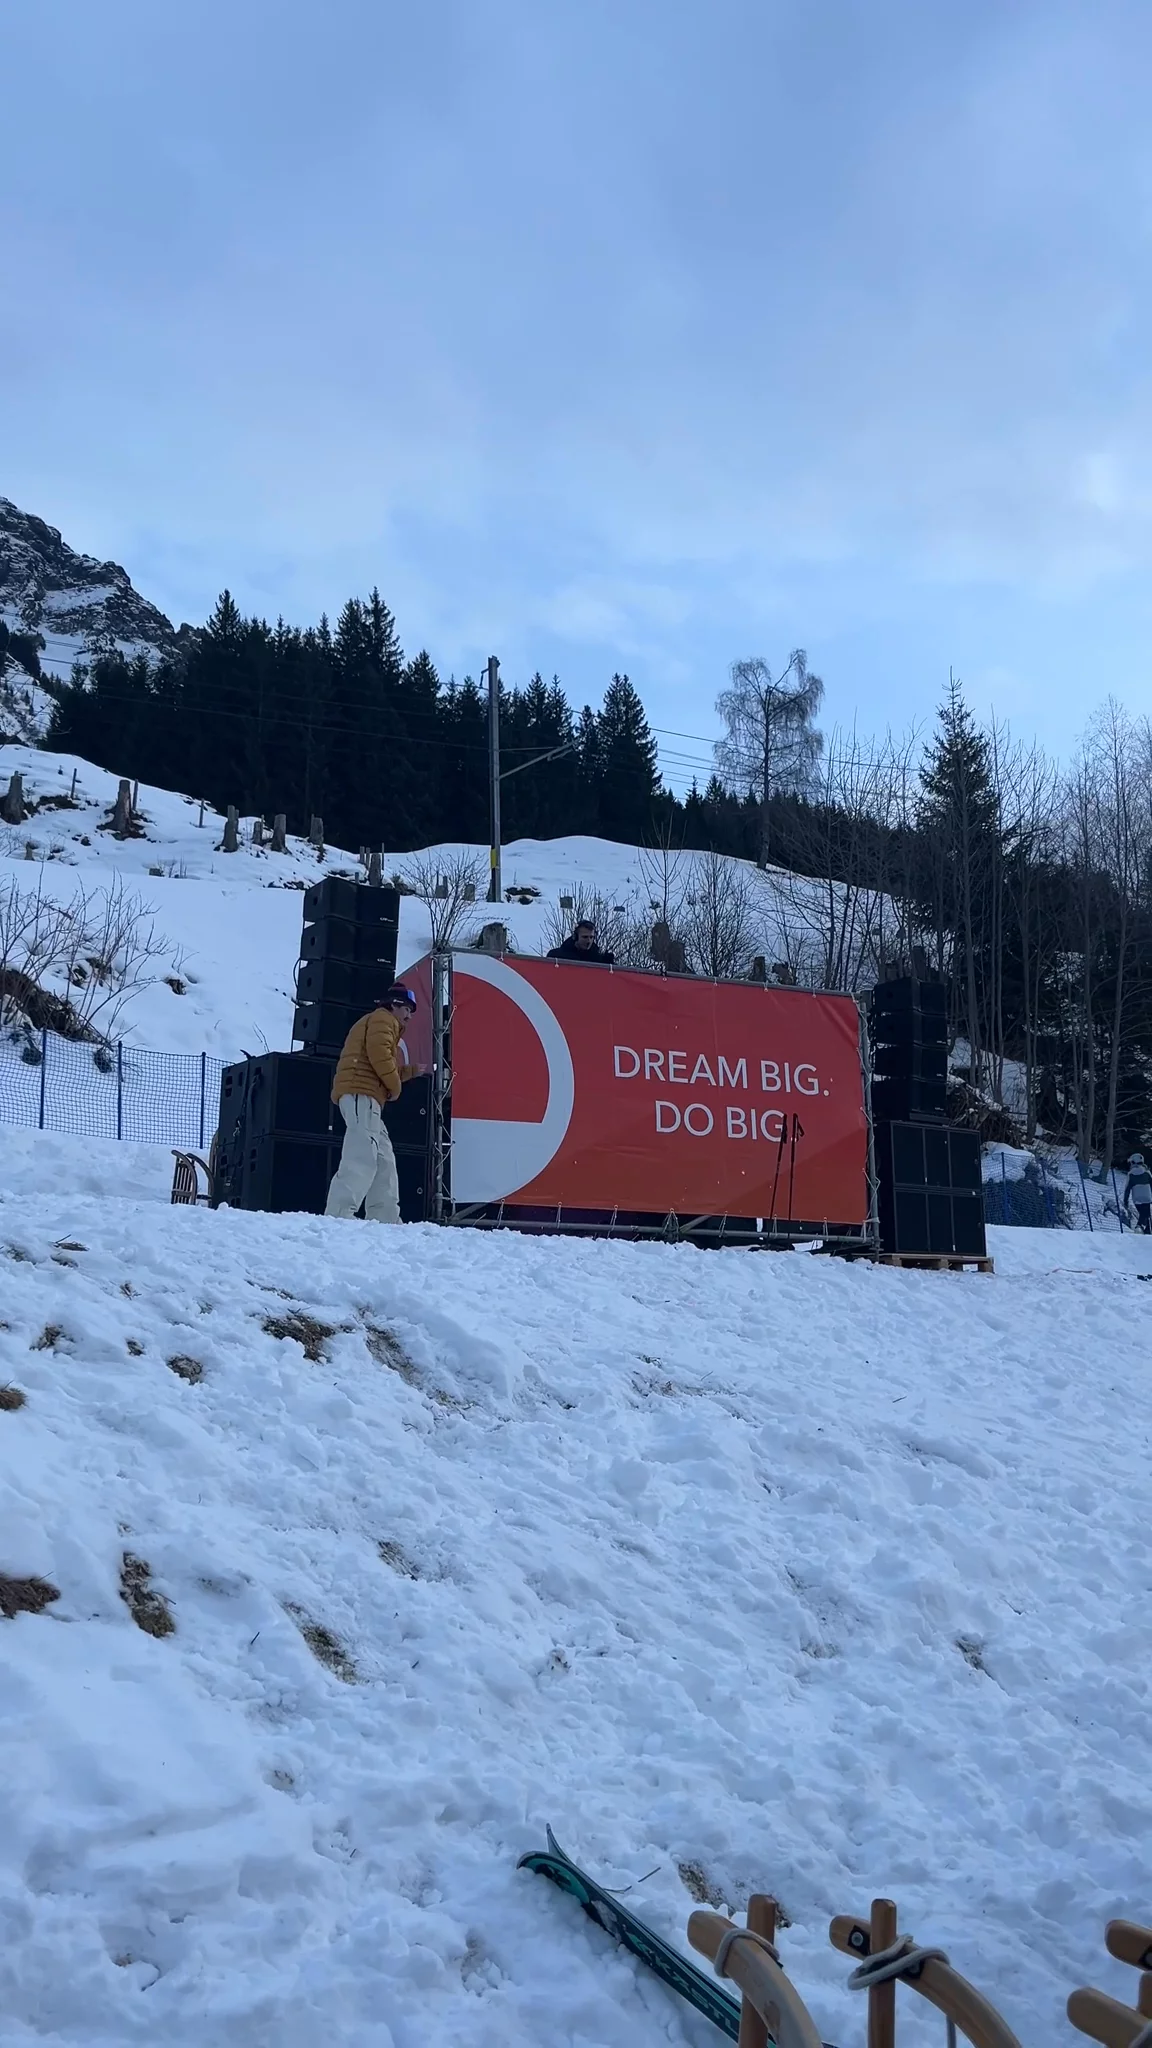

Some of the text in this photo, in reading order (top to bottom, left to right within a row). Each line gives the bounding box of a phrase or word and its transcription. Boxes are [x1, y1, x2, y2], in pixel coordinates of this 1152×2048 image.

[613, 1045, 830, 1097] DREAM BIG.
[655, 1100, 714, 1137] DO
